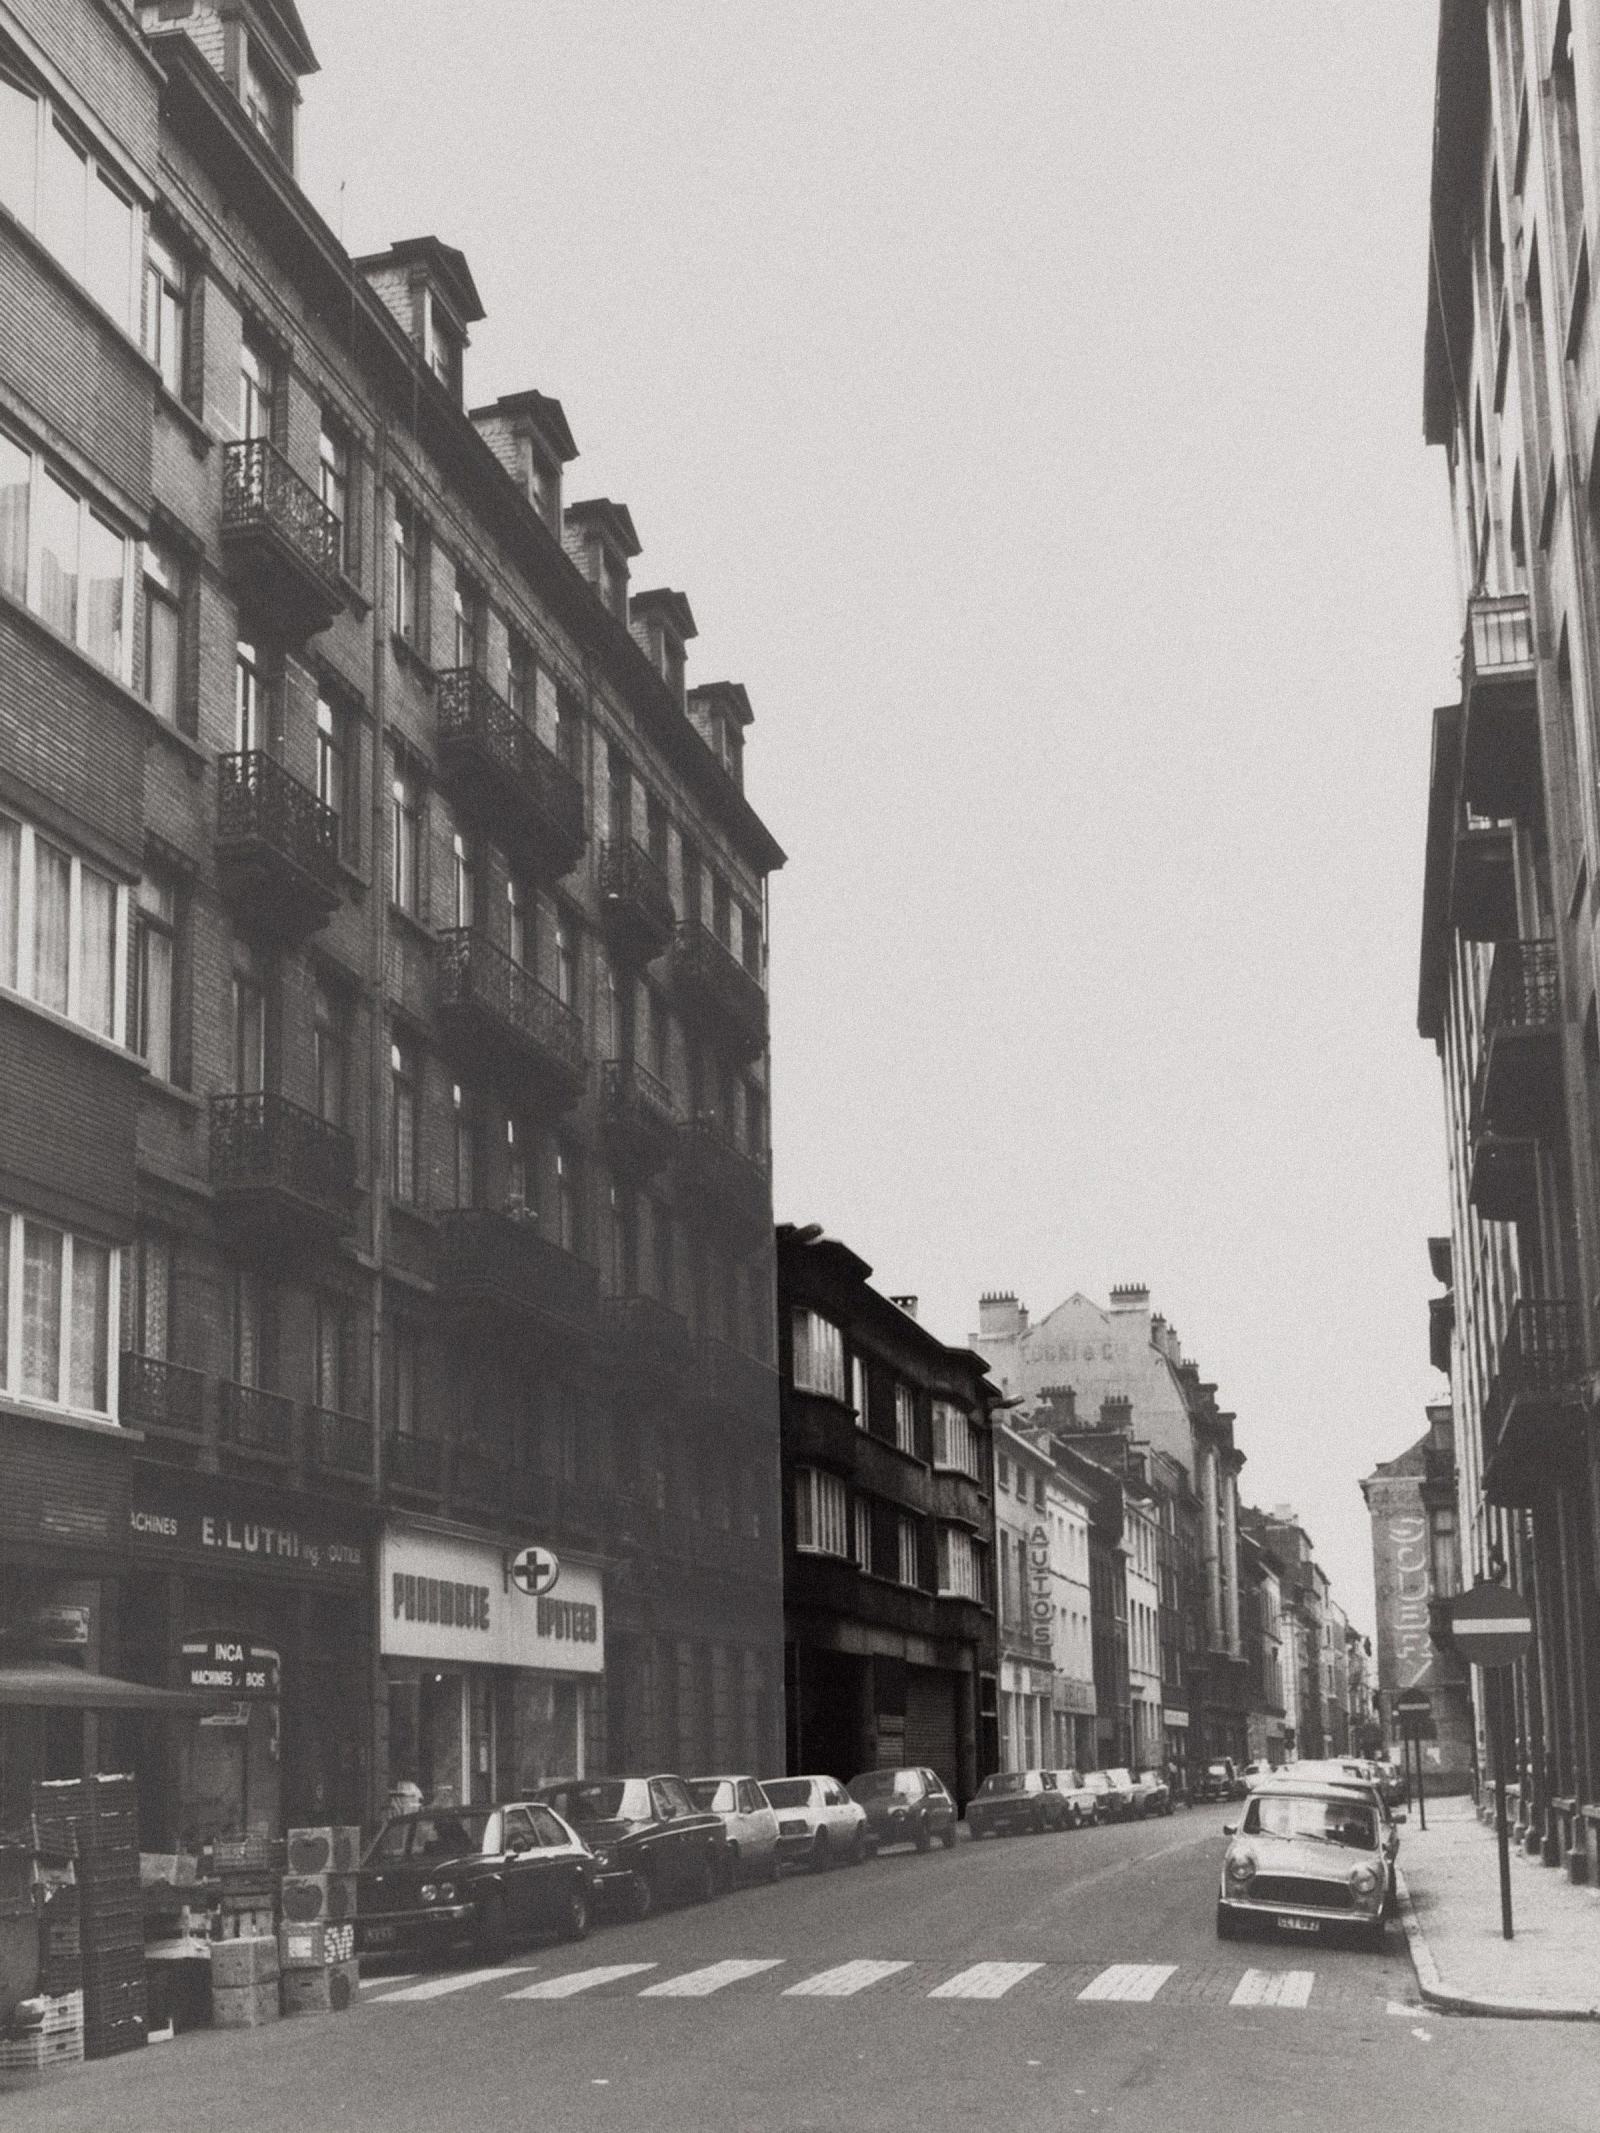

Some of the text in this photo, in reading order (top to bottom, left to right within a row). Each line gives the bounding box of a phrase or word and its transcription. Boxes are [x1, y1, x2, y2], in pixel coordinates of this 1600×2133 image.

[393, 1572, 490, 1631] PHARMACIE
[1031, 1525, 1050, 1645] AUTOS
[215, 1644, 243, 1661] INCA
[191, 1669, 233, 1686] MACHINES
